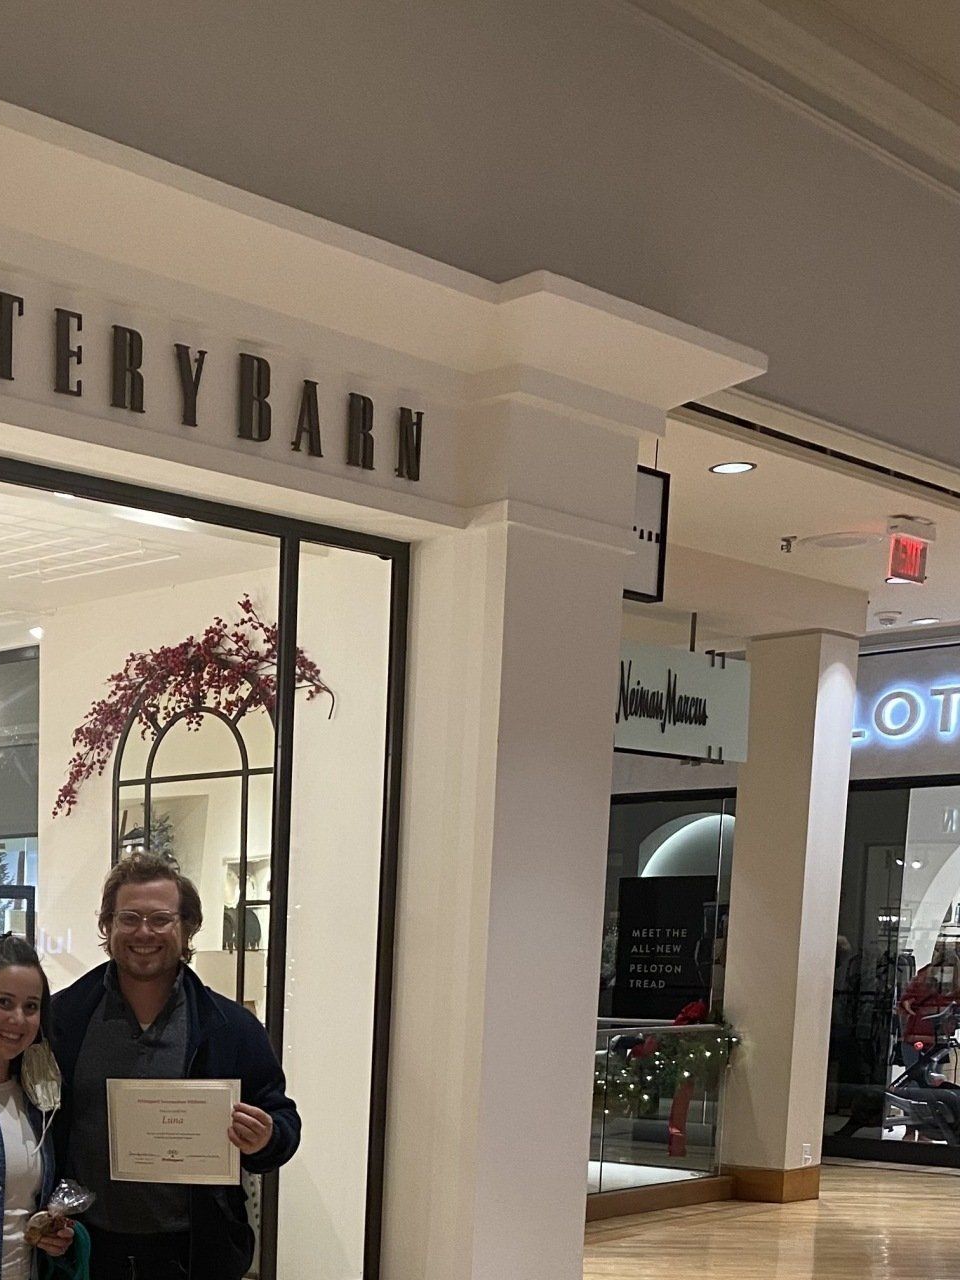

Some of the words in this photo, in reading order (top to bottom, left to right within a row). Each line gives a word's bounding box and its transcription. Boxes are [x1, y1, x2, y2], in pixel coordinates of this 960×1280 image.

[615, 660, 664, 724] Neiman
[661, 668, 708, 733] Marcus
[852, 684, 960, 738] OT
[632, 928, 662, 938] MEET
[666, 928, 688, 938] THE
[630, 944, 682, 953] ALL-NEW
[629, 964, 682, 974] PELOTON
[629, 979, 666, 989] TREAD
